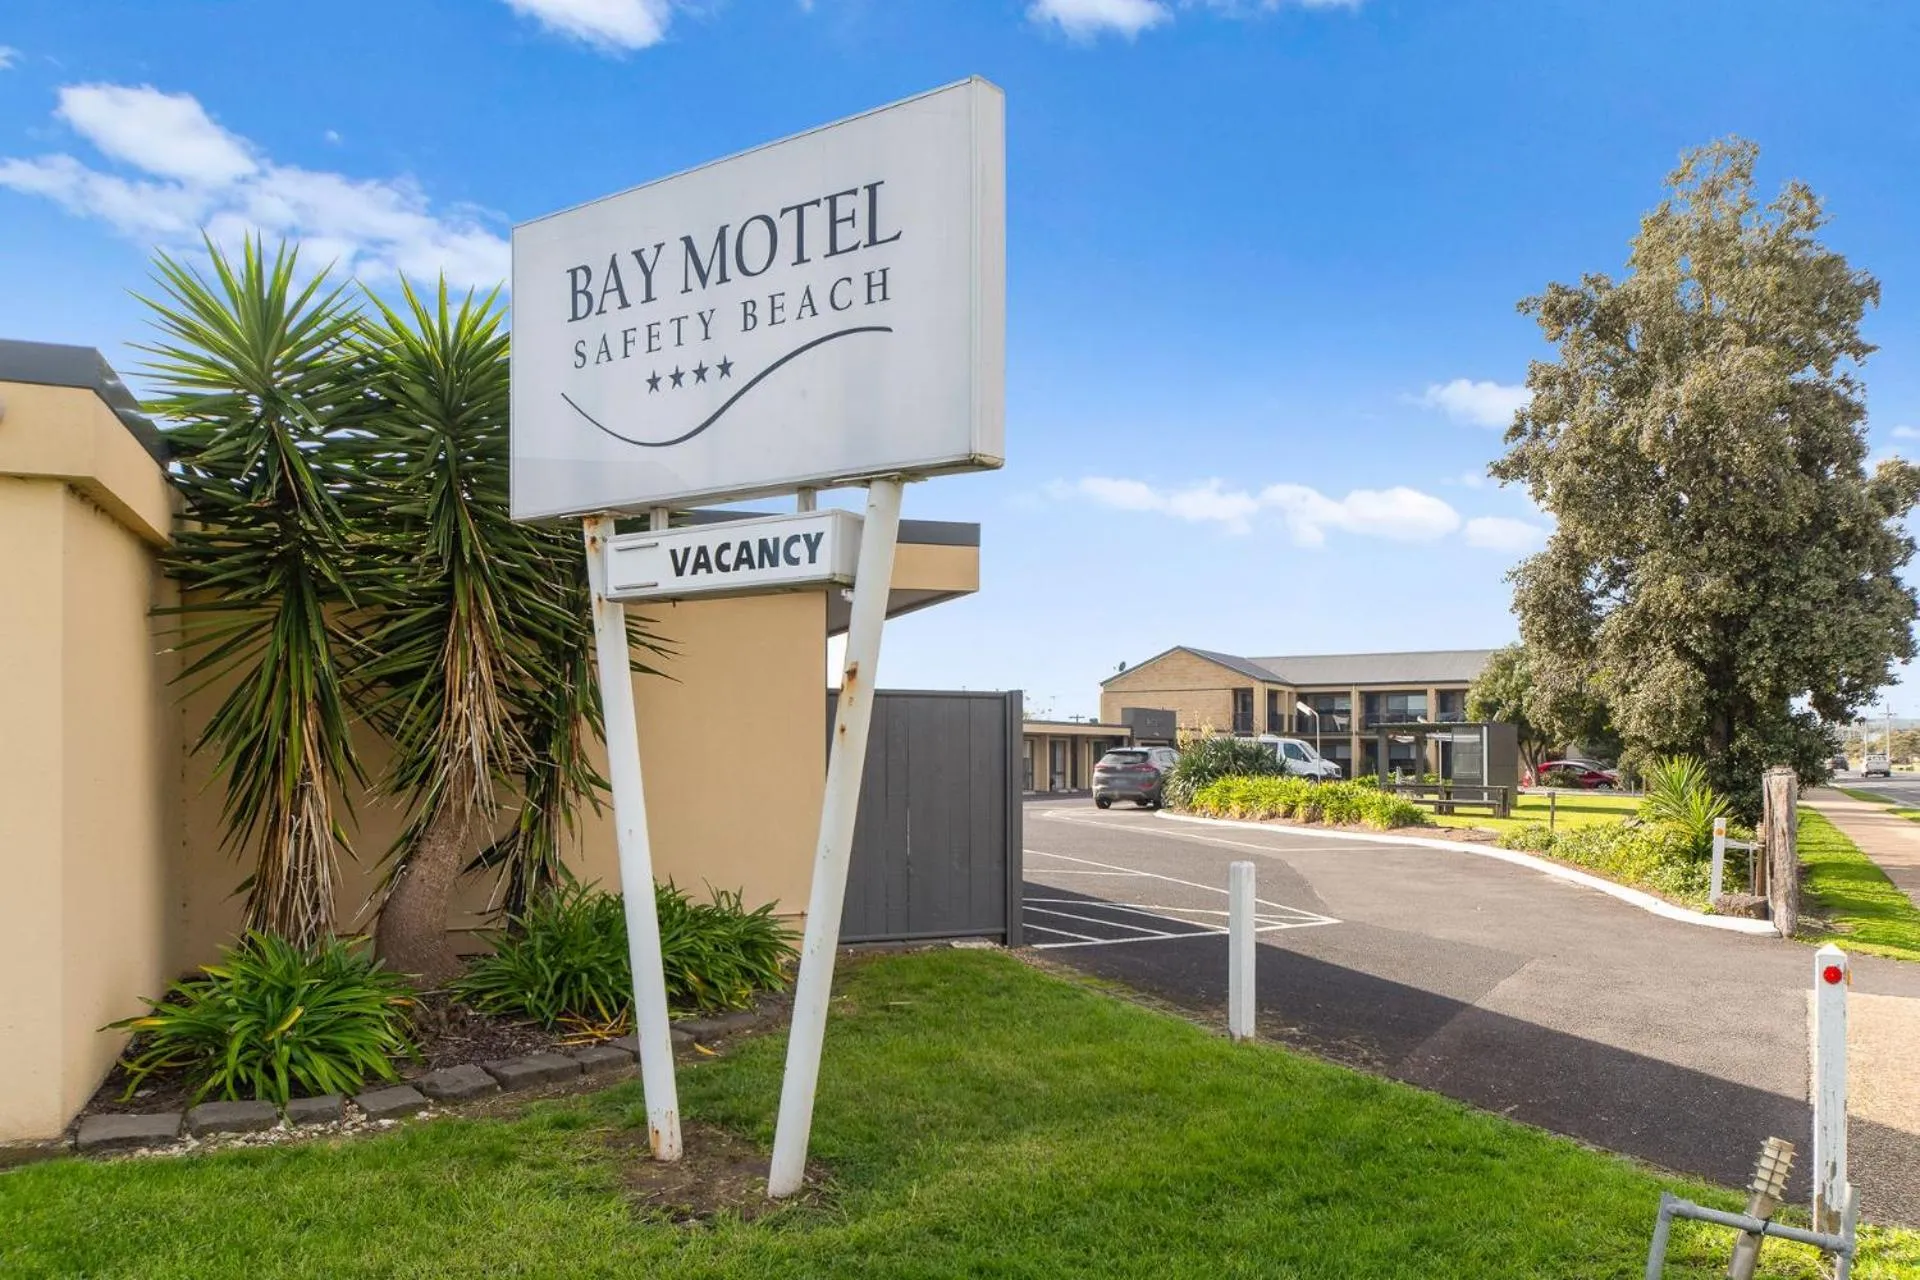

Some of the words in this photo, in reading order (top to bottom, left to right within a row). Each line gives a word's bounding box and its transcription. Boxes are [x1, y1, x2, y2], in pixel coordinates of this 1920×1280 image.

[566, 242, 664, 323] BAY
[679, 180, 903, 295] MOTEL
[574, 308, 717, 369] SAFETY
[740, 266, 891, 333] BEACH
[669, 531, 825, 578] VACANCY
